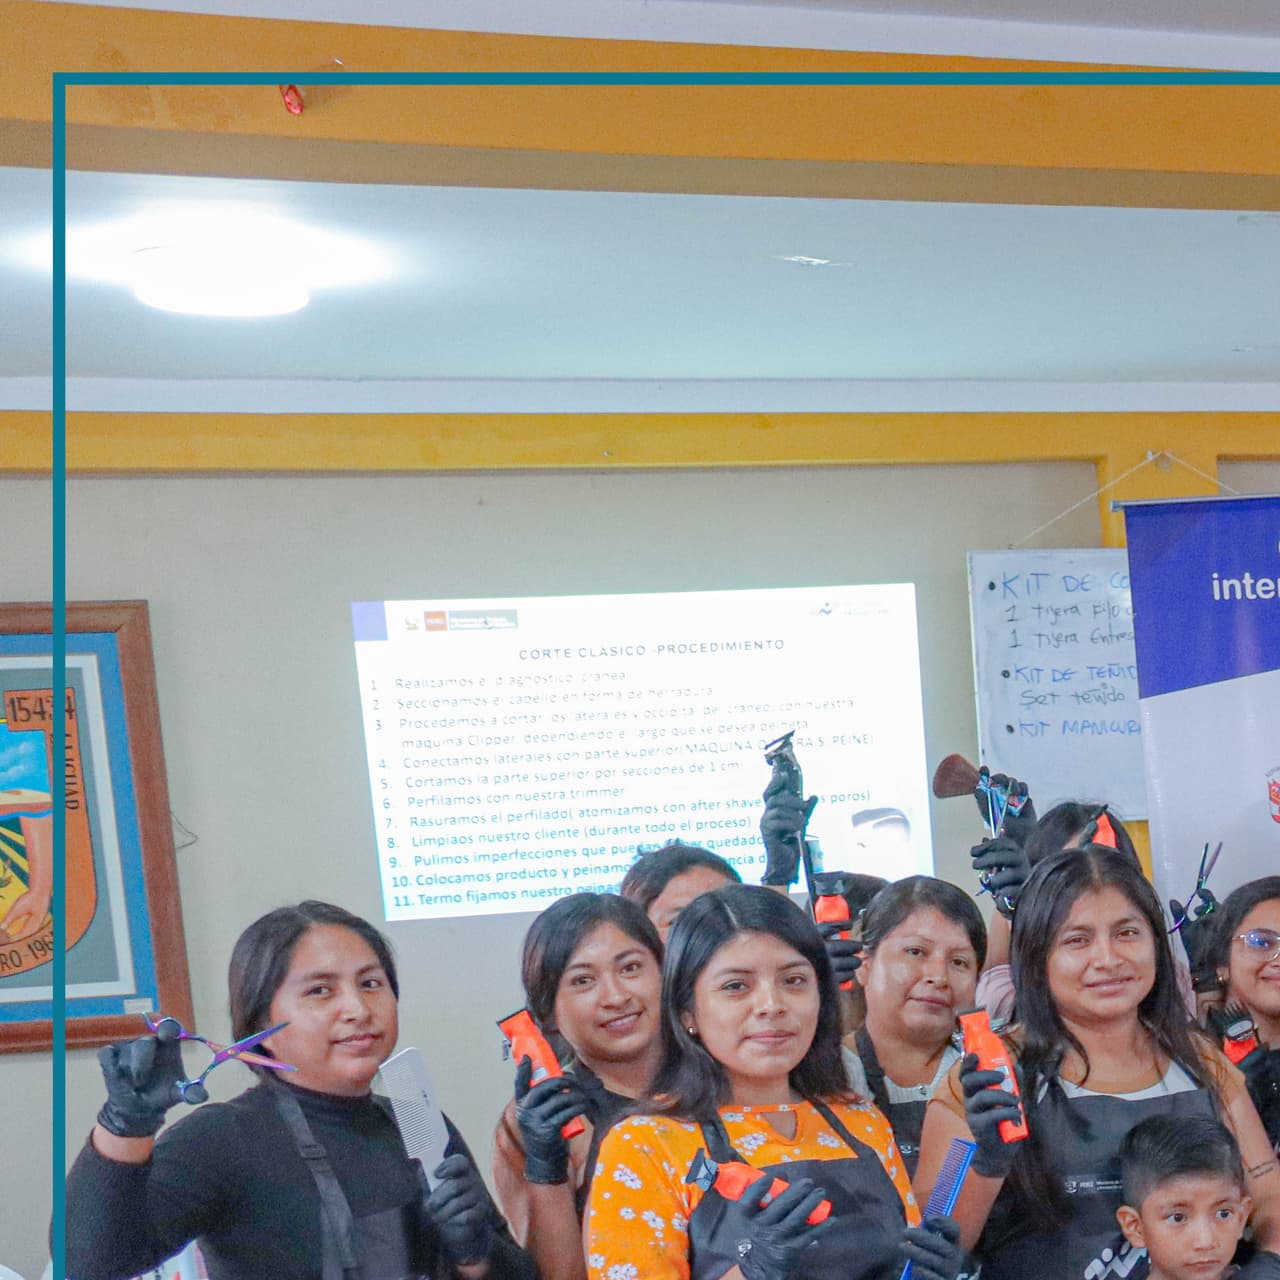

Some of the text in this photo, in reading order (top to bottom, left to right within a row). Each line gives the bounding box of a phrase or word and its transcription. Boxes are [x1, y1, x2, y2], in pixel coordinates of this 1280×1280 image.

[1002, 571, 1050, 599] KIT
[1062, 574, 1093, 593] DE
[519, 647, 572, 661] CORTE
[578, 644, 646, 658] CLASICO
[1014, 666, 1045, 684] KIT
[1051, 668, 1078, 683] DE
[1018, 718, 1051, 737] KIT
[405, 775, 473, 789] Cortamos
[407, 794, 482, 808] Perfilamos
[486, 791, 511, 804] con
[515, 789, 566, 802] nuestra
[409, 814, 487, 828] Rasuramos
[578, 803, 659, 819] atomizamos
[662, 801, 686, 814] con
[690, 799, 721, 812] after
[478, 830, 531, 843] nuestro
[534, 825, 580, 840] cliente
[645, 819, 676, 834] todo
[679, 818, 691, 831] el
[413, 853, 470, 867] Pulimos
[473, 846, 578, 865] imperfecciones
[581, 845, 607, 859] que
[416, 872, 492, 887] Colocamos
[495, 867, 558, 884] producto
[418, 892, 463, 907] Termo
[466, 888, 517, 905] fijamos
[521, 885, 573, 899] nuestro
